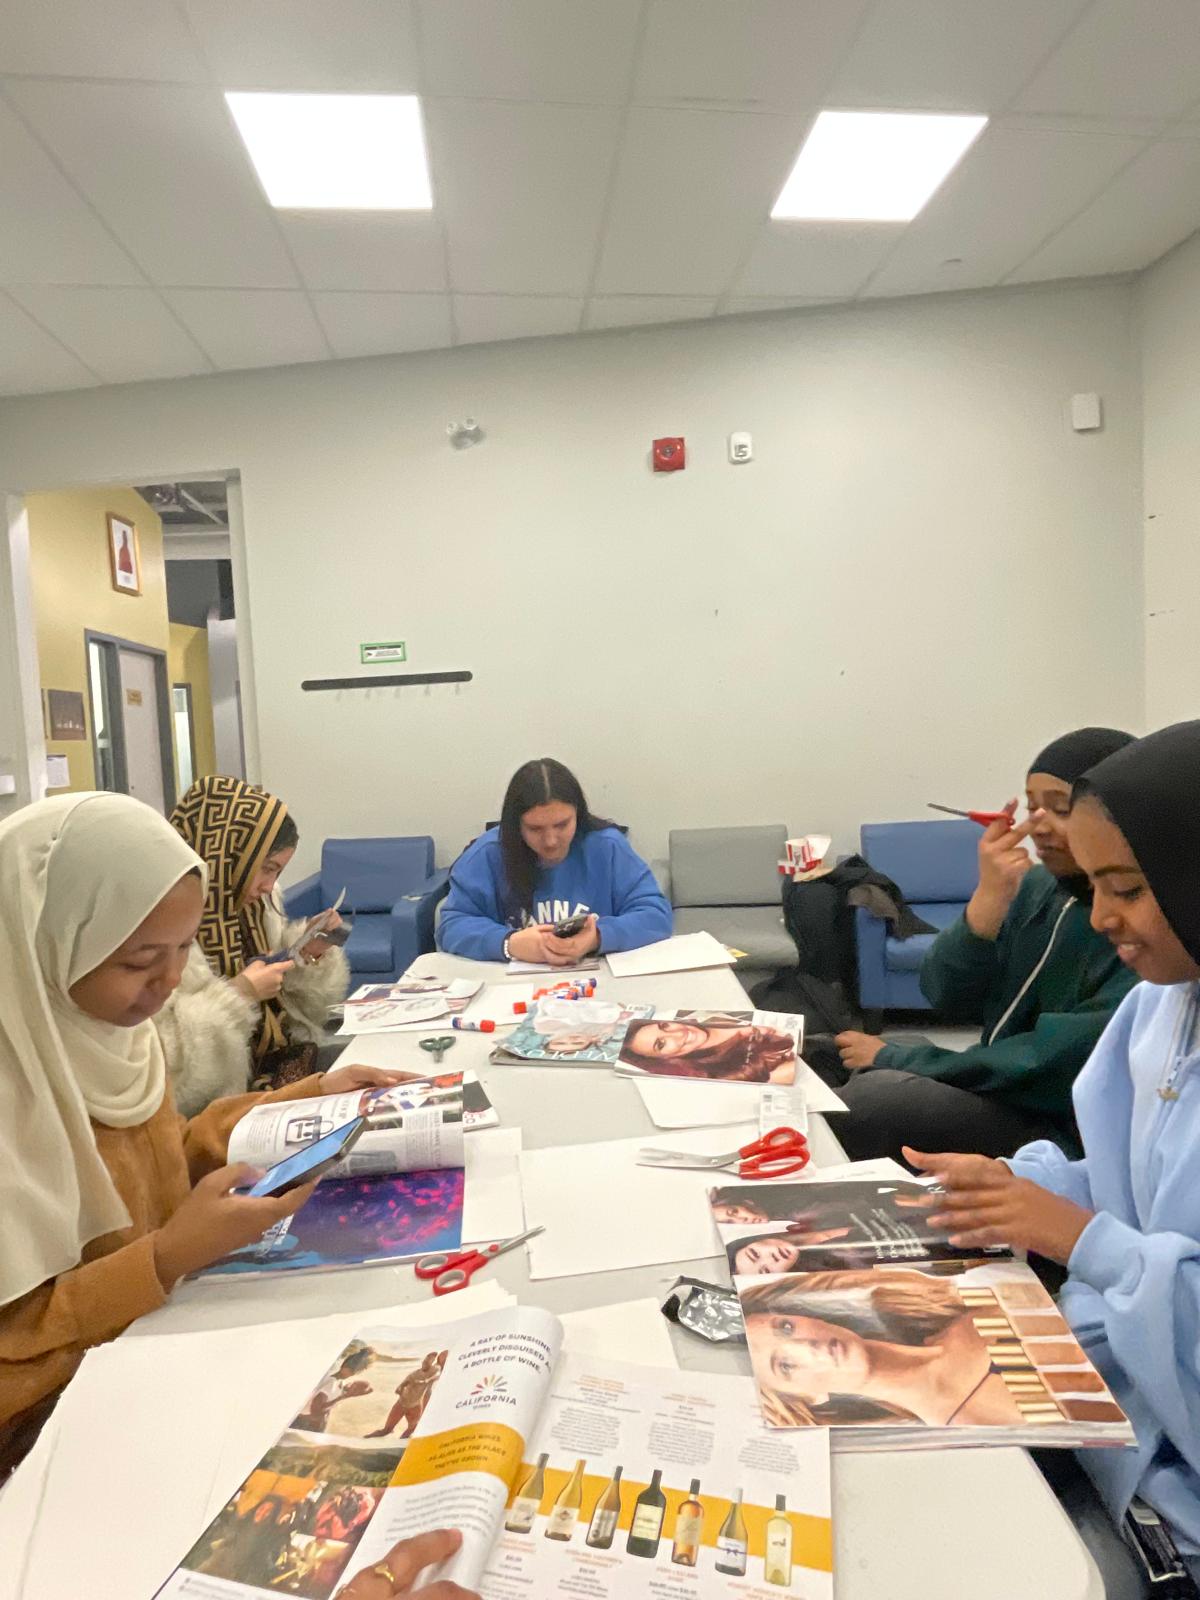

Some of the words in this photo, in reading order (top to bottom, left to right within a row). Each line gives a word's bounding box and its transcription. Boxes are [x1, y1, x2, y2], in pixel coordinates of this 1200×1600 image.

[477, 1337, 493, 1345] RAY
[458, 1346, 497, 1361] CLEVERLY
[498, 1344, 545, 1361] DISGUISED
[470, 1355, 502, 1368] BOTTLE
[455, 1395, 517, 1409] CALIFORNIA
[482, 1444, 507, 1456] PLACE
